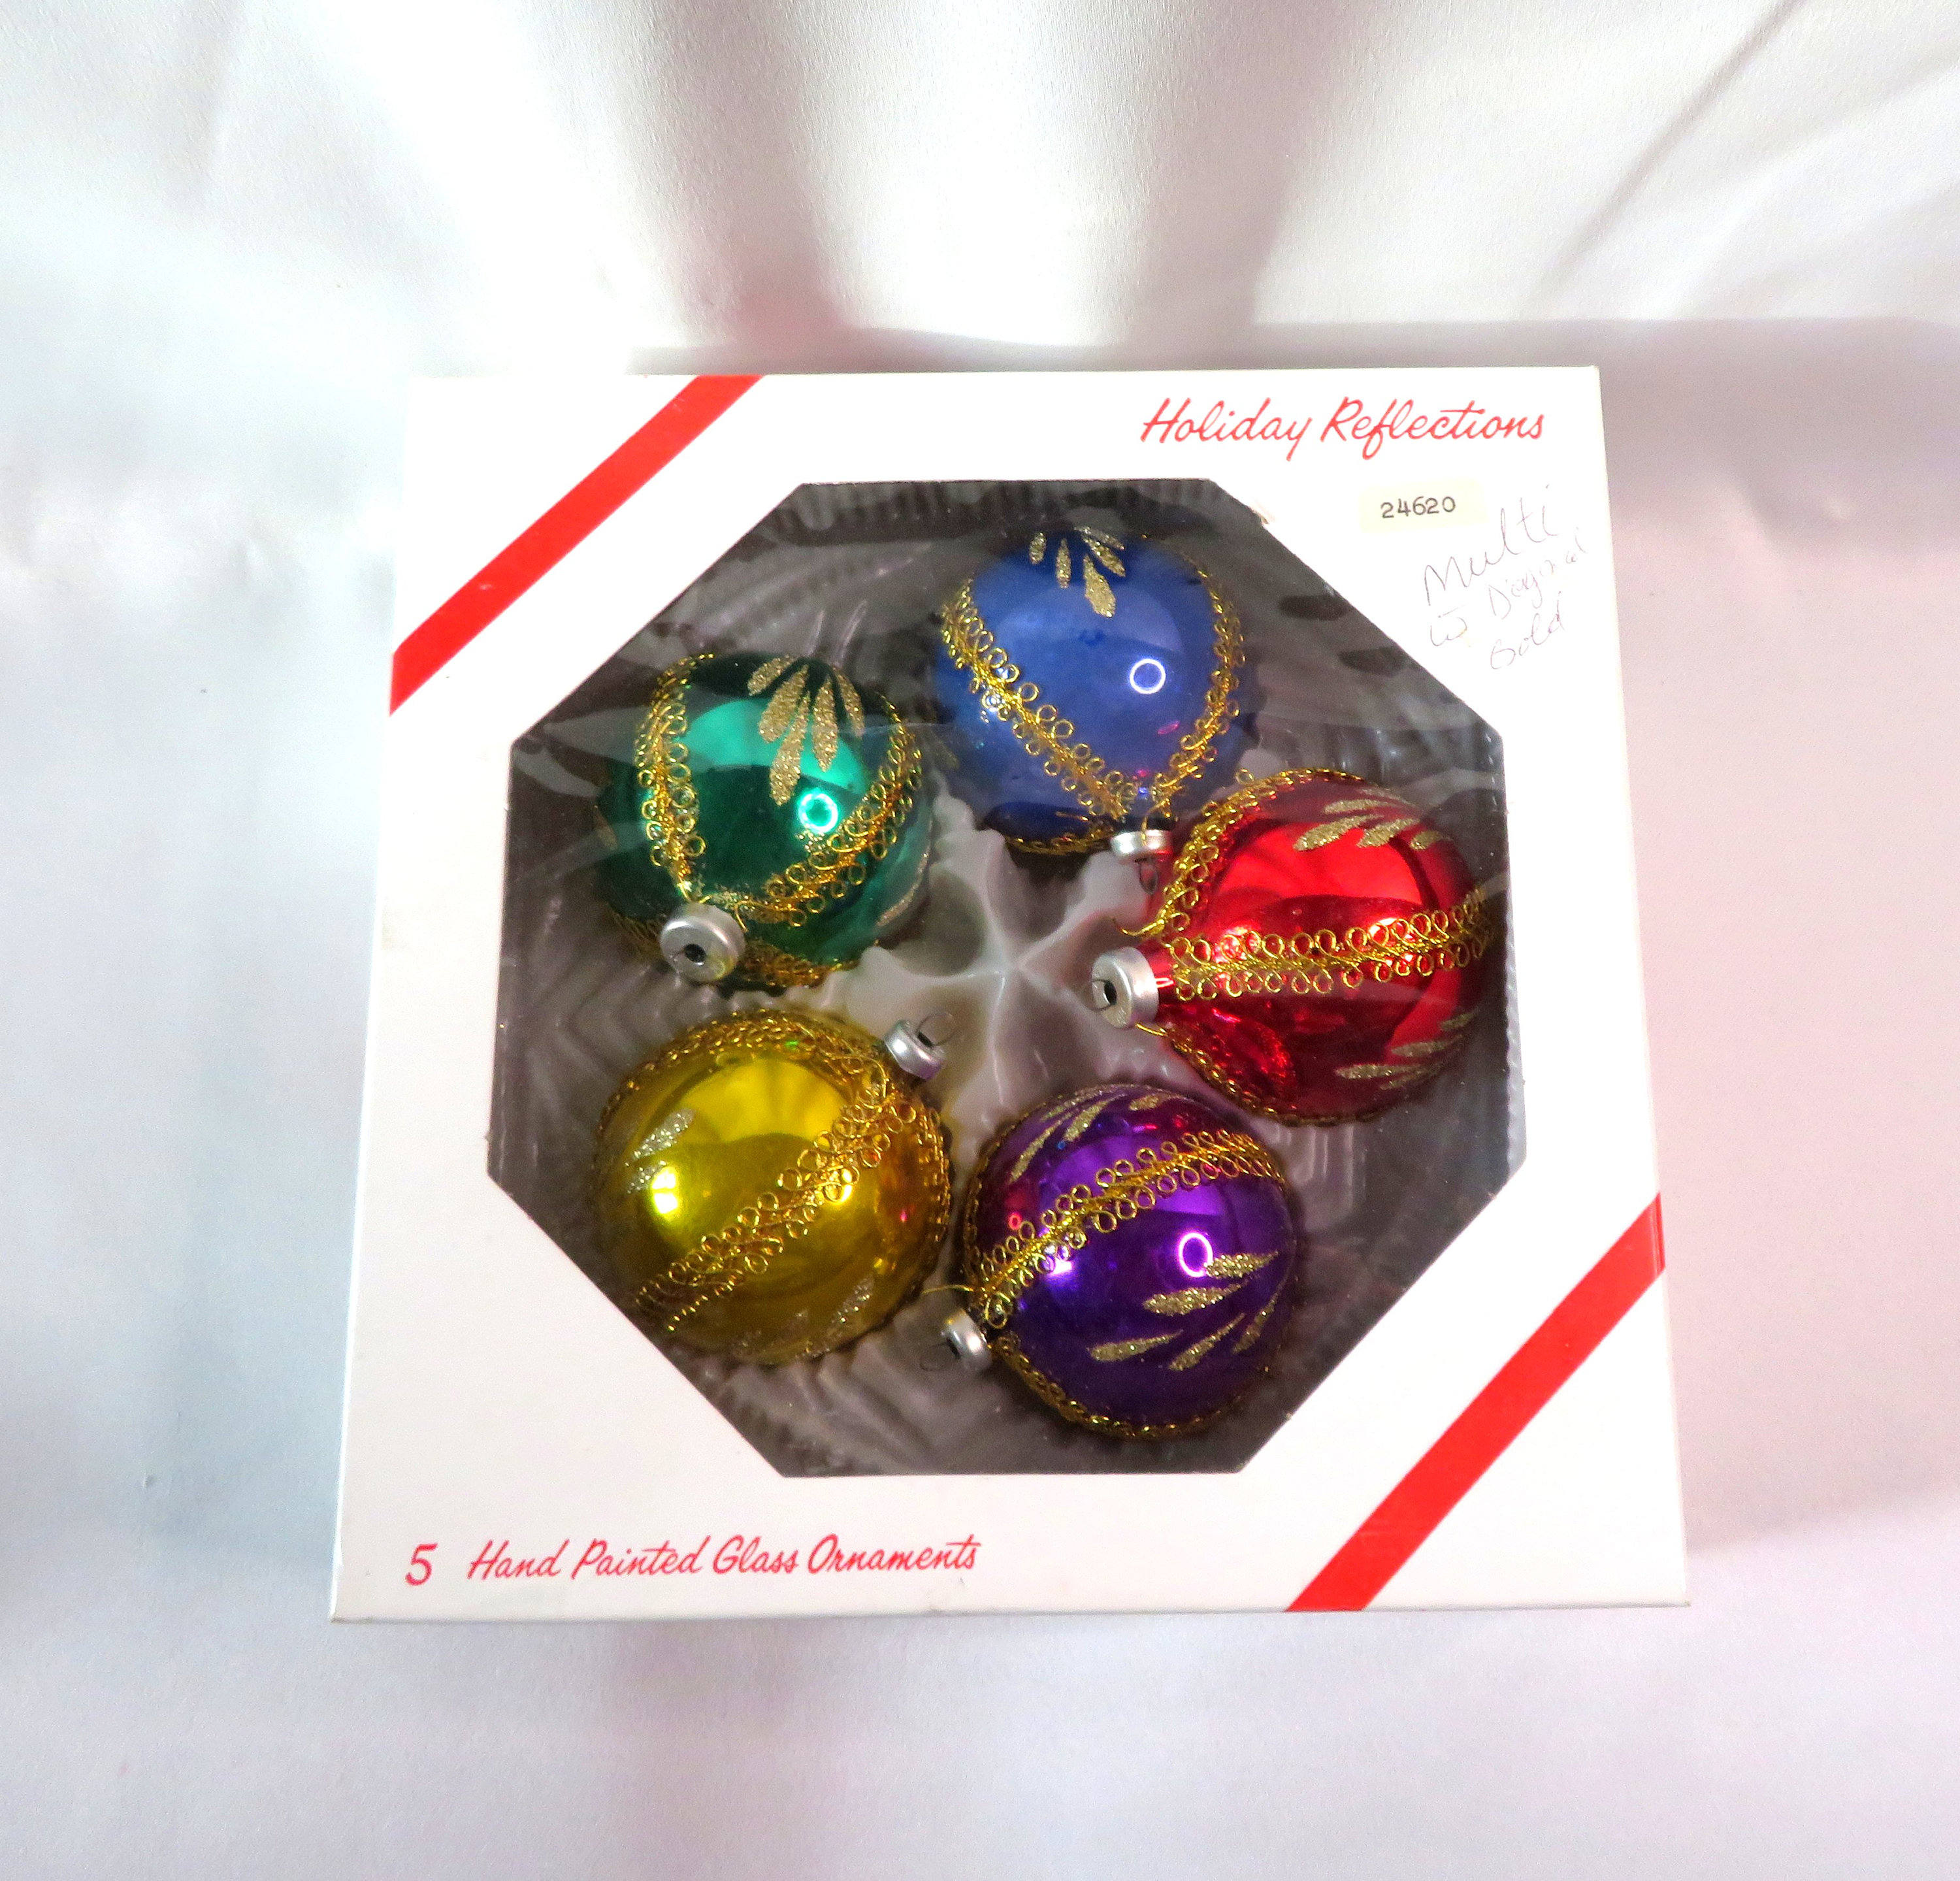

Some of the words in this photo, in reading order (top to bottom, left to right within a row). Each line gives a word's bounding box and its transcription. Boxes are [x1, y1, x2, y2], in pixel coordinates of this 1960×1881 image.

[1140, 397, 1313, 461] Holiday
[1320, 396, 1545, 461] Reflections
[1381, 496, 1456, 519] 24620
[1423, 483, 1559, 606] Multi
[405, 1543, 438, 1586] 5
[467, 1539, 570, 1580] Hand
[570, 1535, 711, 1580] Painted
[712, 1534, 799, 1575] Glass
[807, 1533, 981, 1575] Ornaments
